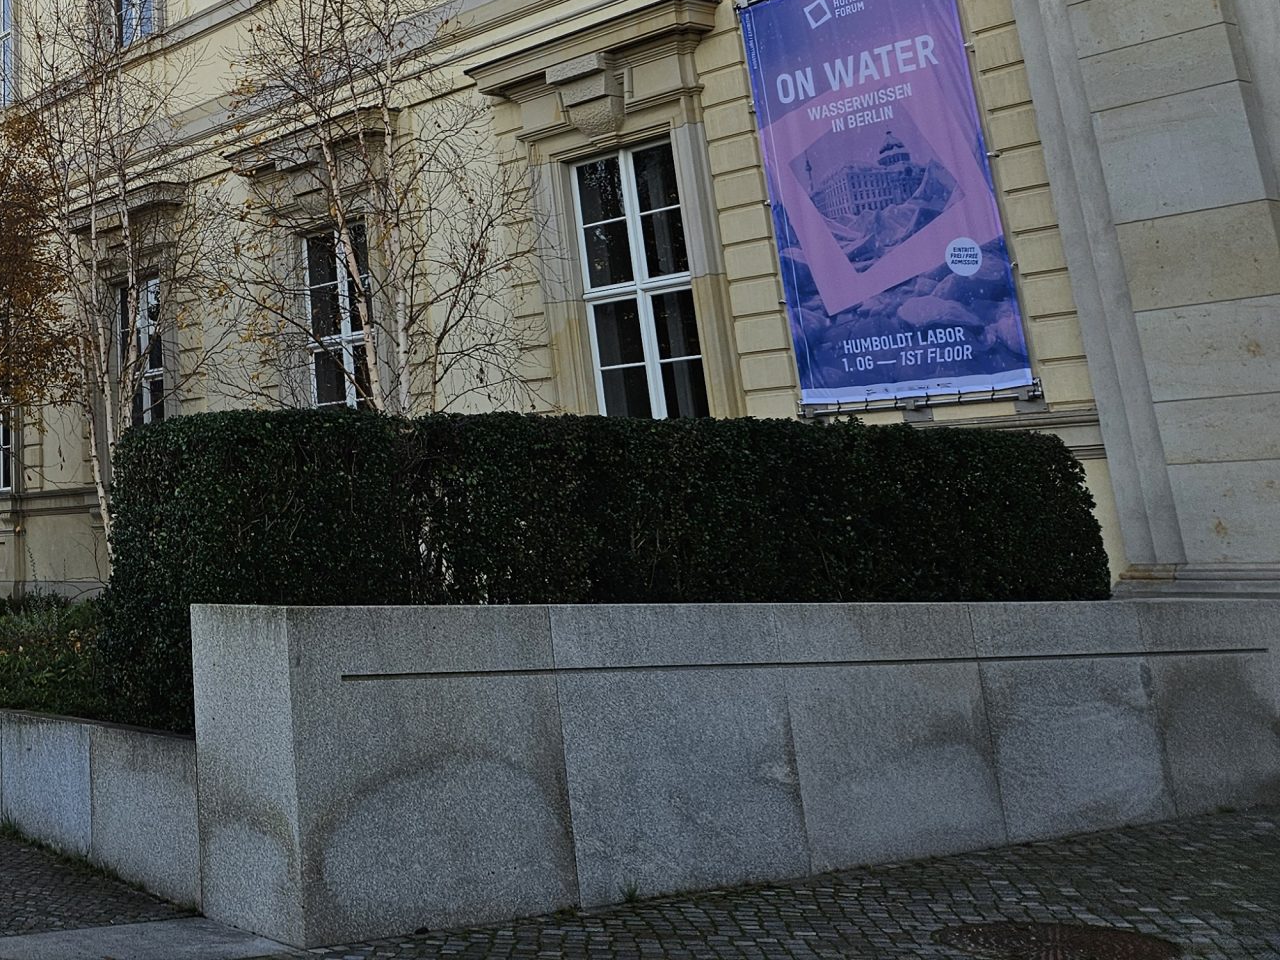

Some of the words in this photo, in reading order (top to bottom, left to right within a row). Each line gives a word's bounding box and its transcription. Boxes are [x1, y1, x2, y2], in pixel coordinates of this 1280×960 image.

[834, 1, 865, 19] FORUM
[776, 67, 816, 104] ON
[823, 34, 939, 92] WATER
[807, 82, 912, 121] WASSERWISSEN
[831, 118, 845, 133] IN
[847, 105, 894, 129] BERLIN
[843, 332, 913, 354] HUMBOLDT
[917, 327, 965, 346] LABOR
[841, 357, 854, 372] 1.
[856, 355, 874, 371] OG
[899, 350, 923, 366] 1ST
[927, 345, 973, 364] FLOOR
